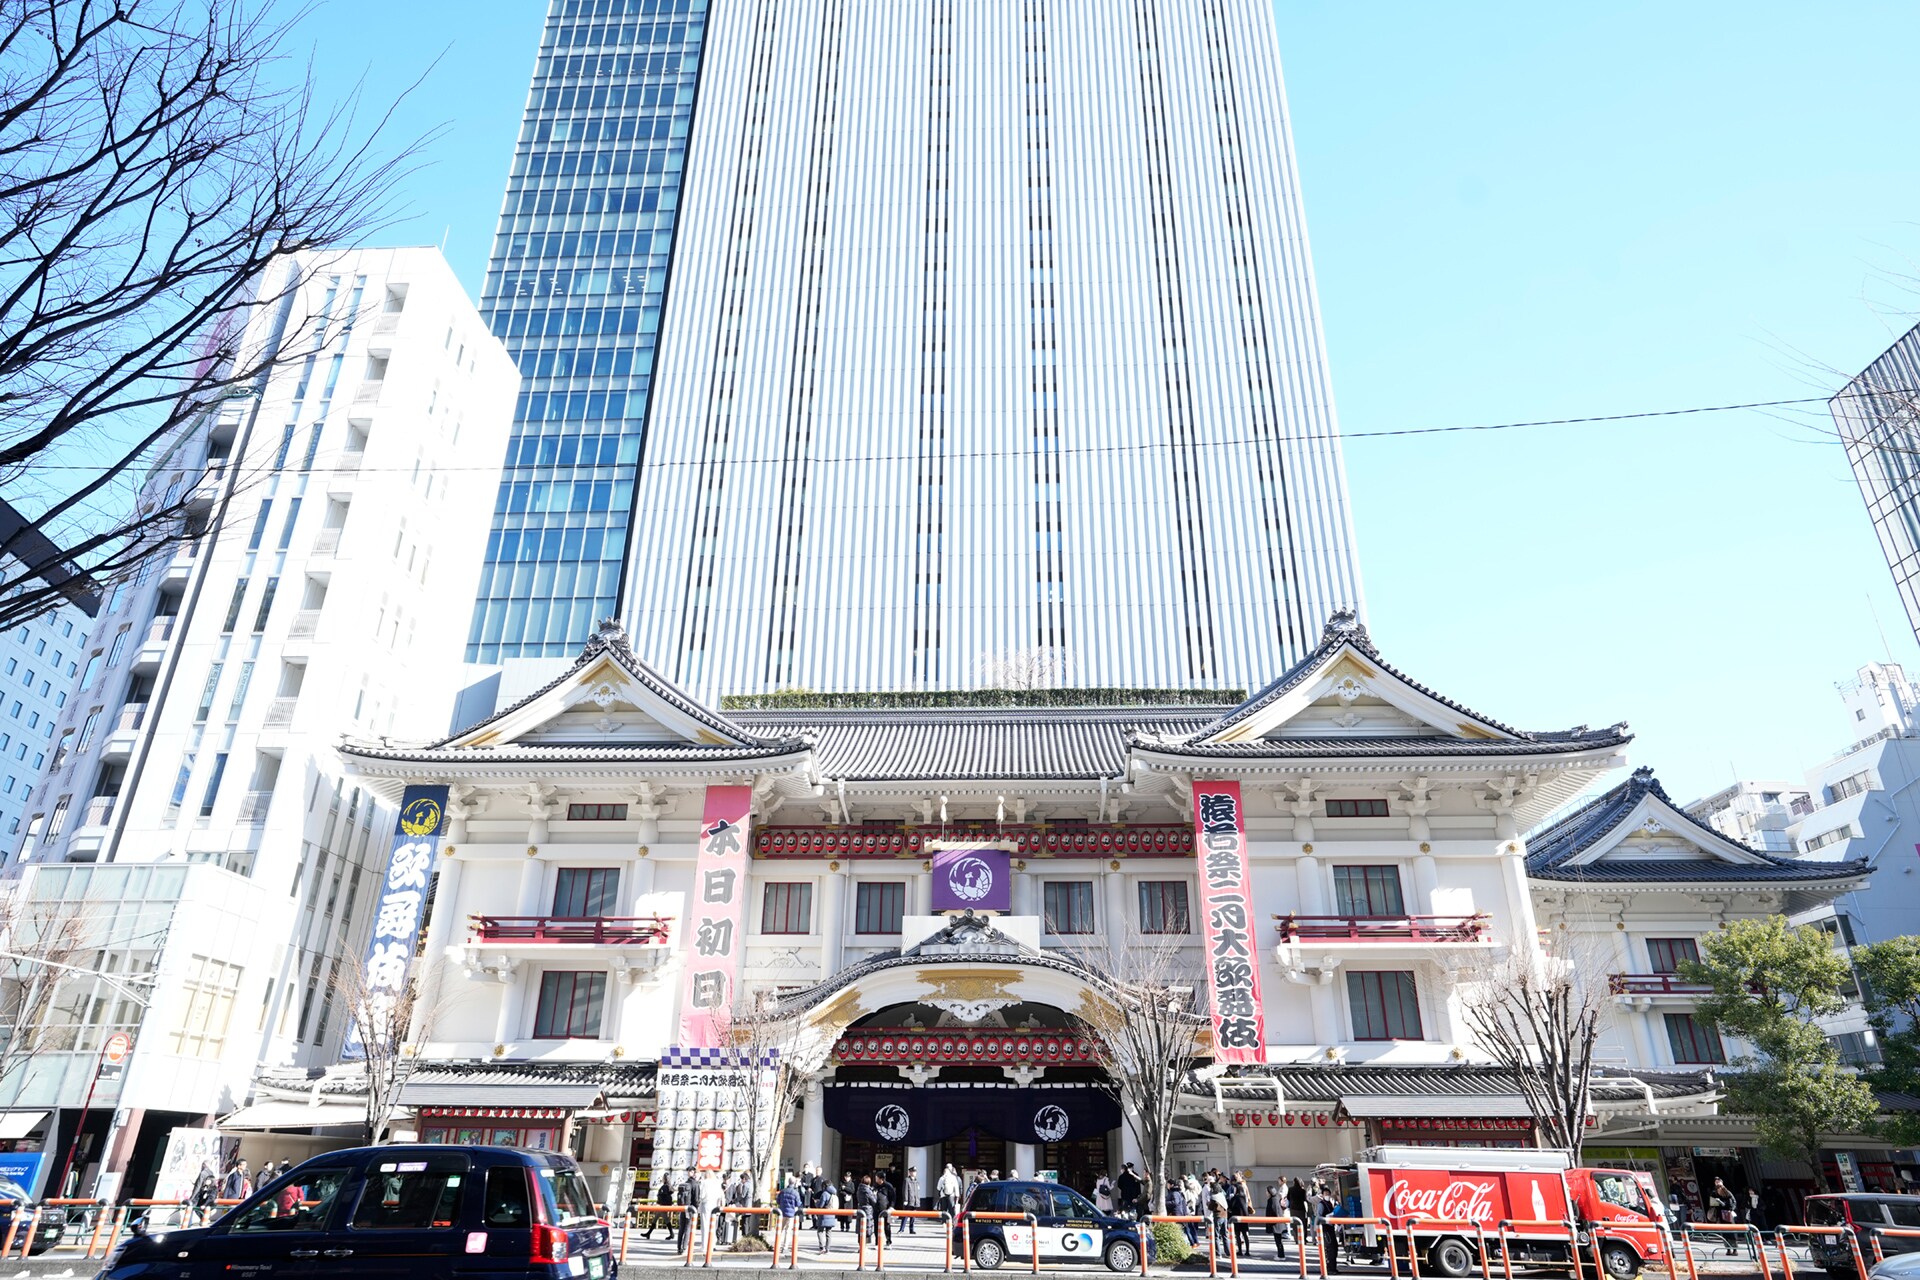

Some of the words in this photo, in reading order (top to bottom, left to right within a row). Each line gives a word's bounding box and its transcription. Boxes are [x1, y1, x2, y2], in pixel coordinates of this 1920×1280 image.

[691, 819, 742, 1009] 本日初日
[1199, 793, 1260, 1049] 猿若祭二月大歌舞伎
[1061, 1233, 1093, 1252] GO
[1383, 1179, 1495, 1222] Coca-Cola
